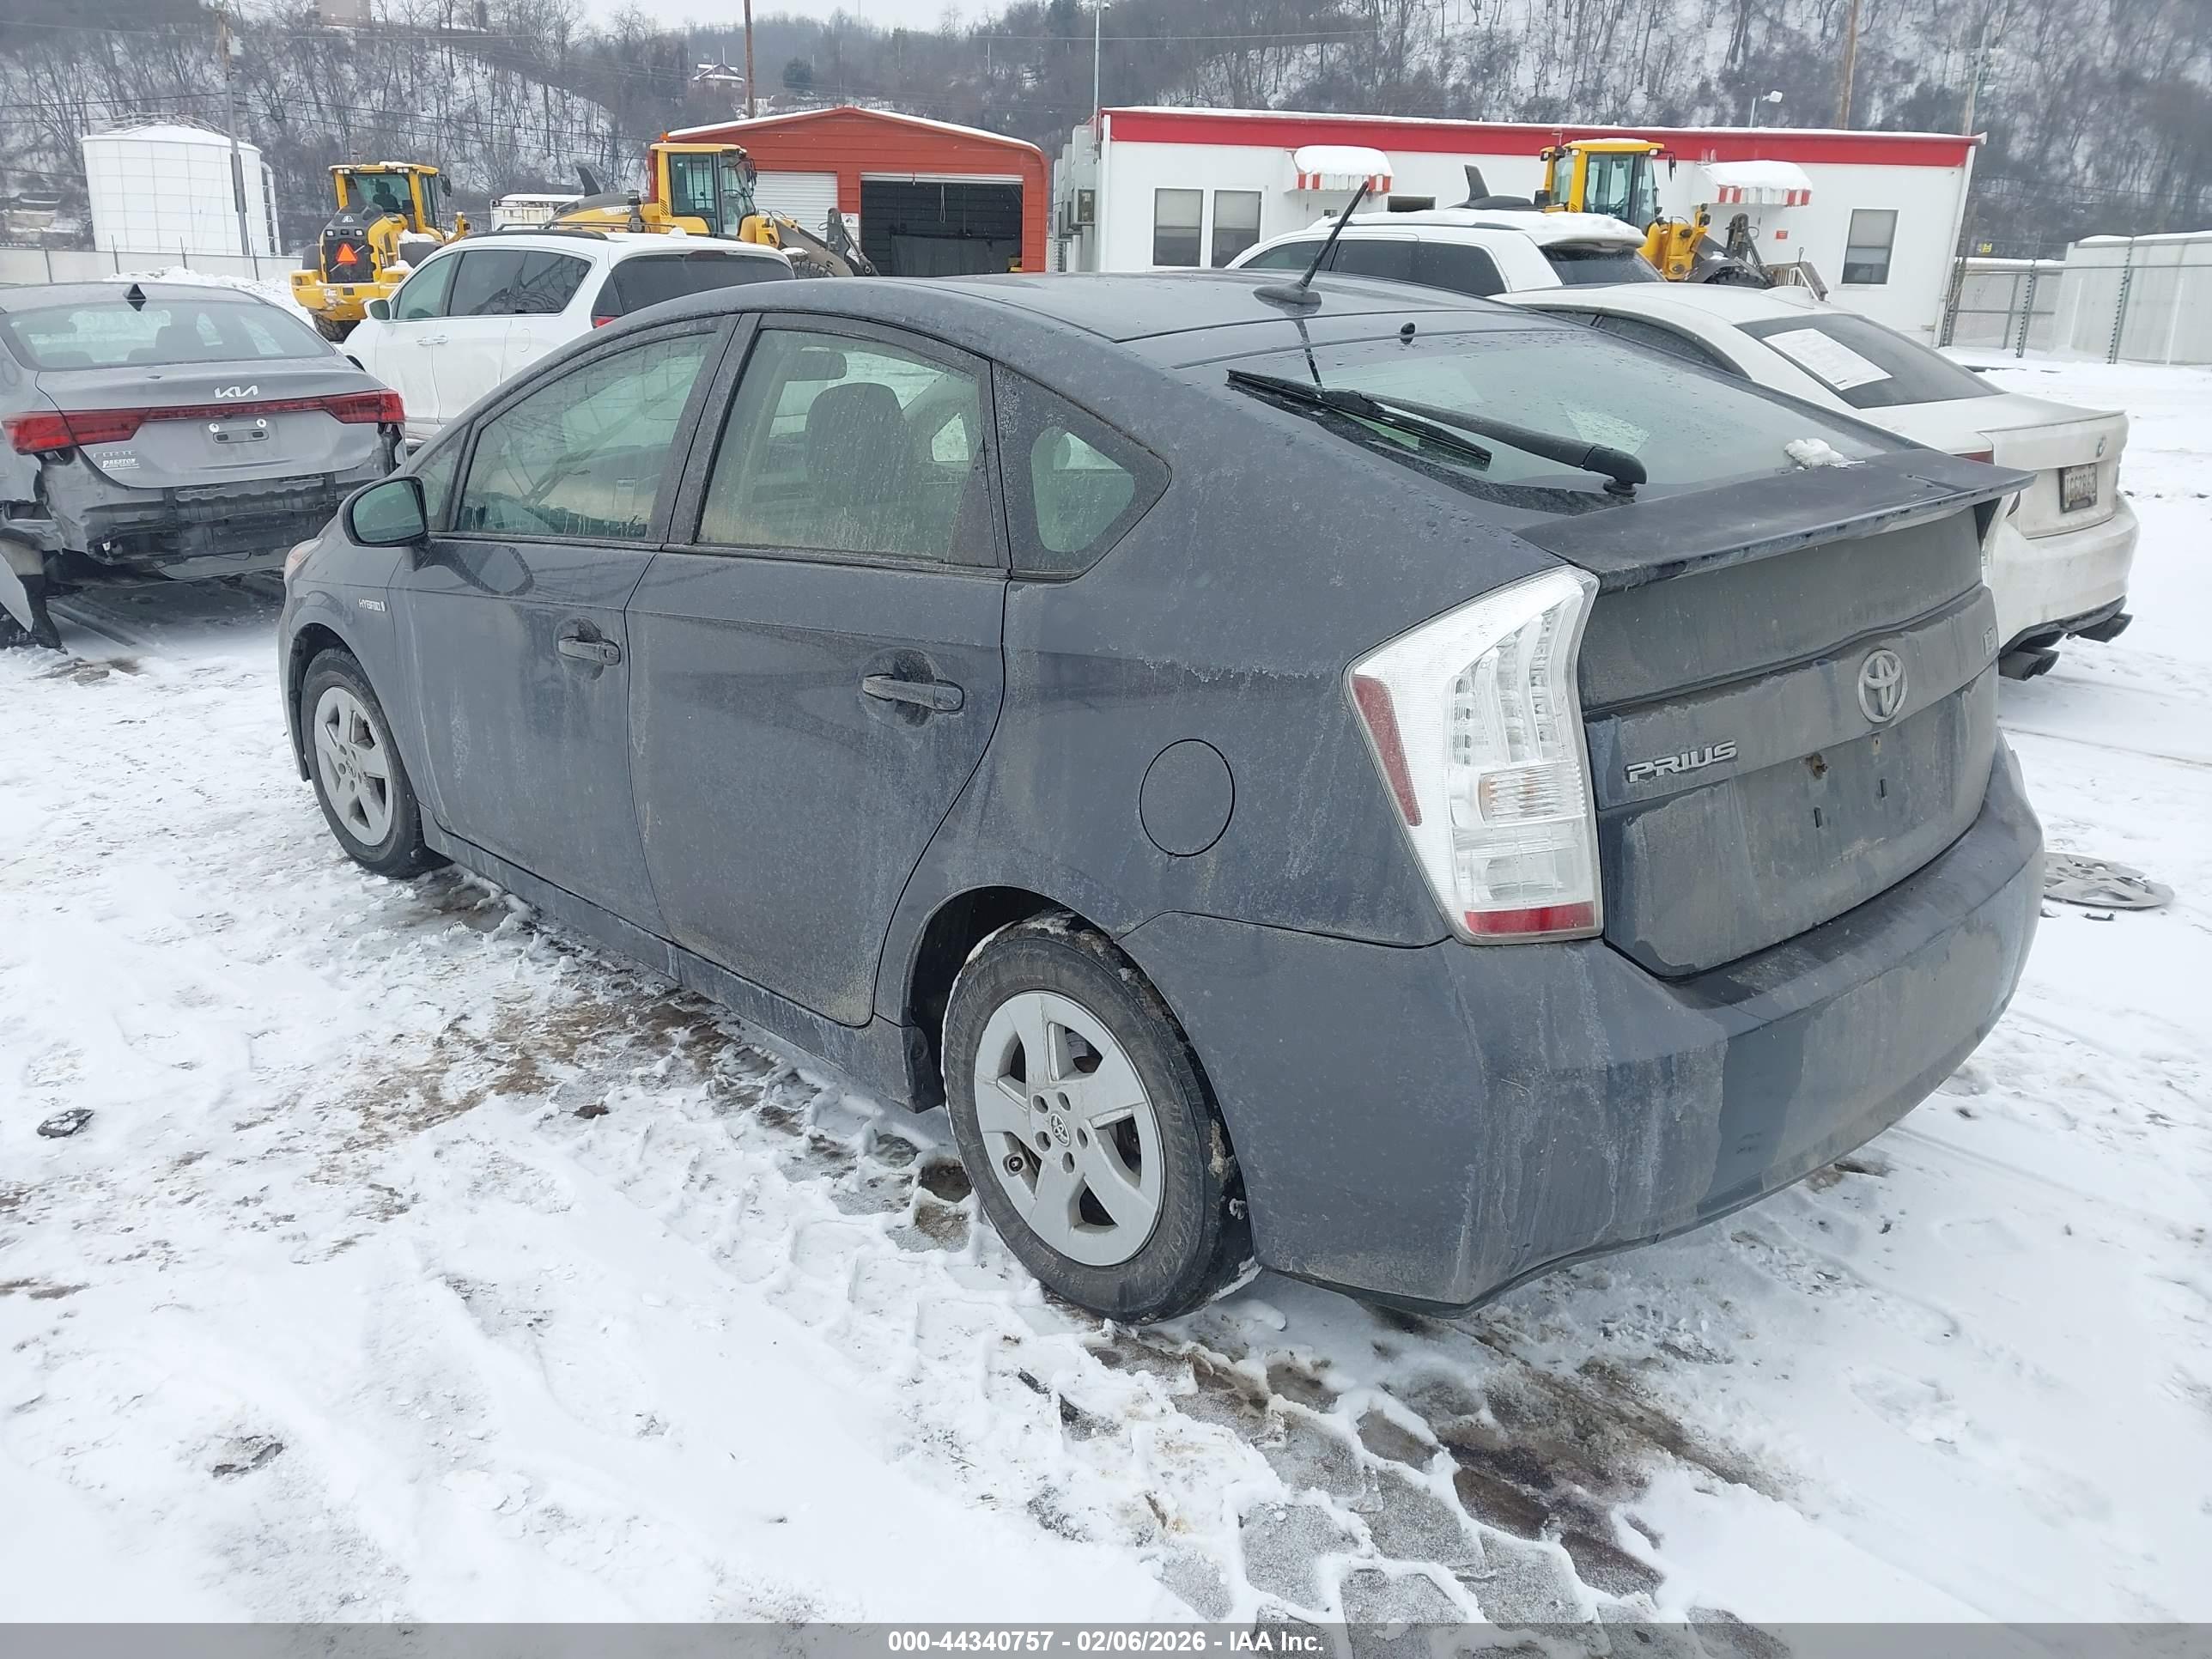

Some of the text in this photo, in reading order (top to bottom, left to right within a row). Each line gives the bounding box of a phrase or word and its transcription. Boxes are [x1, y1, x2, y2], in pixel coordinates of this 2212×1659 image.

[214, 385, 258, 398] KIA
[102, 458, 137, 468] PRESTON
[1626, 739, 1737, 783] PRIUS
